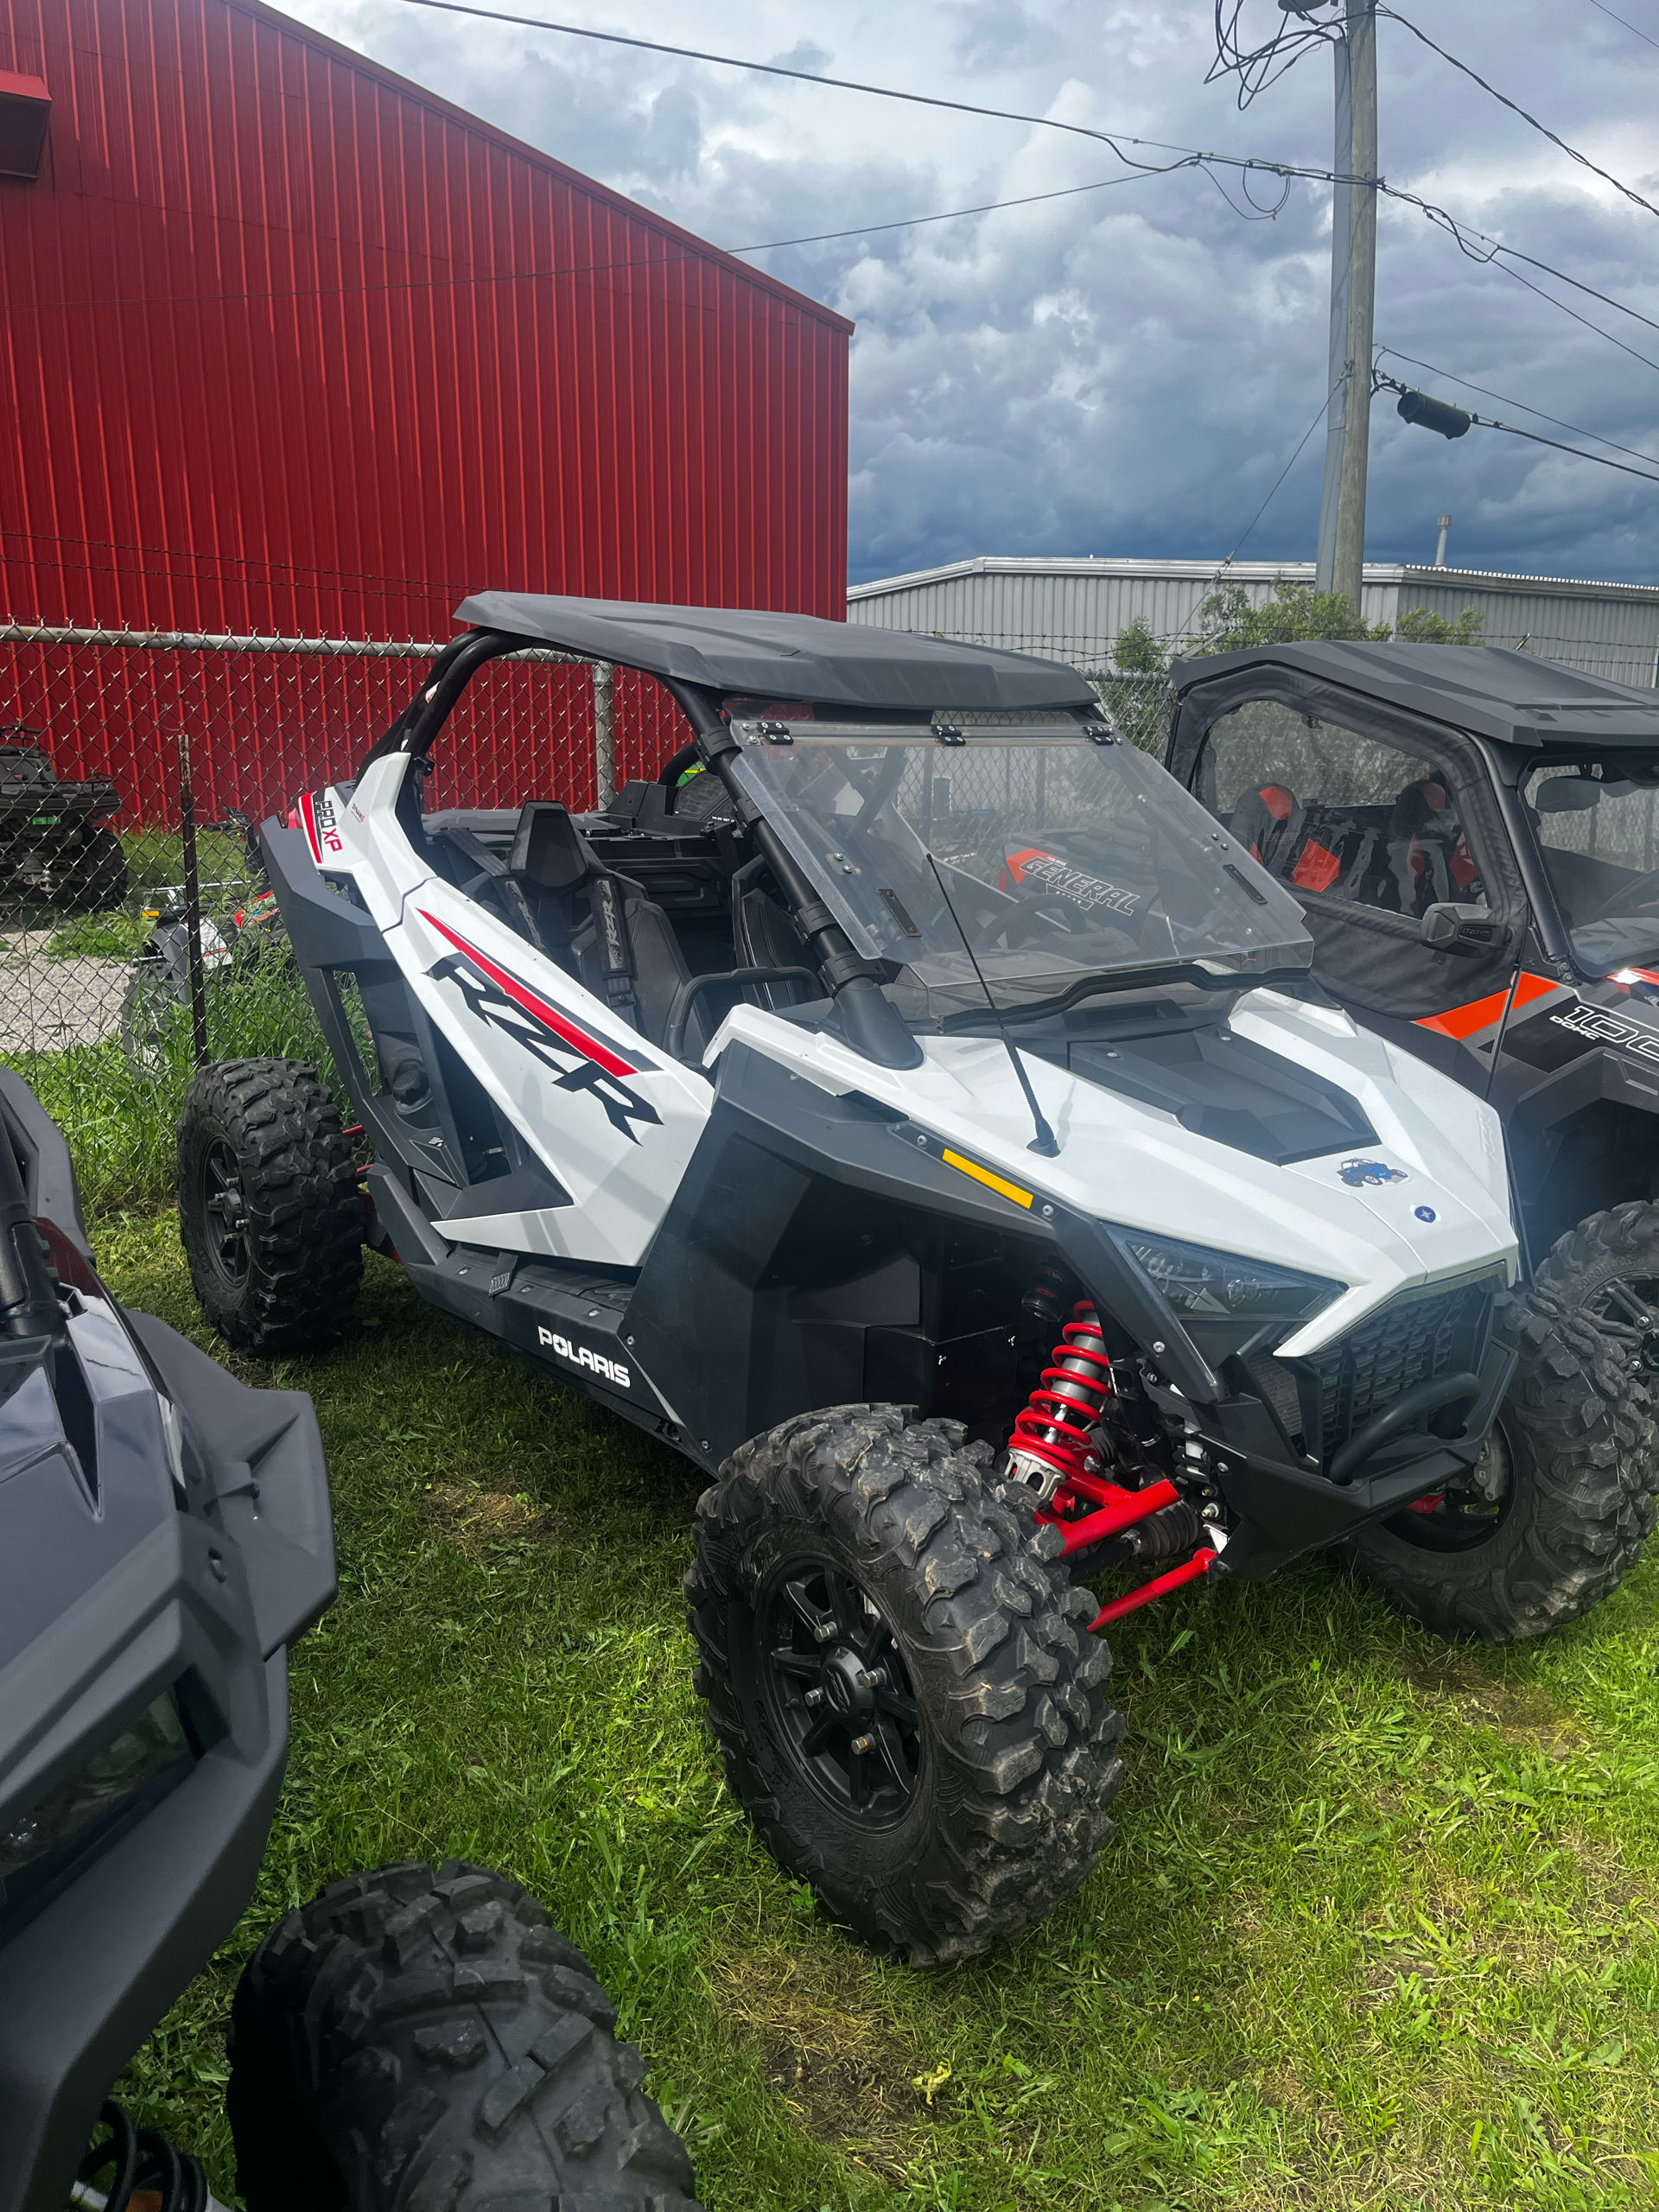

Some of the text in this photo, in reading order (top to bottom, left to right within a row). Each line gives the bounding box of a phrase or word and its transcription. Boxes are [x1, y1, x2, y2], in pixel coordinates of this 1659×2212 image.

[1019, 856, 1141, 916] GENERAL
[420, 950, 665, 1147] RZR
[1549, 1014, 1600, 1041] DOHC
[537, 1325, 631, 1389] POLARIS
